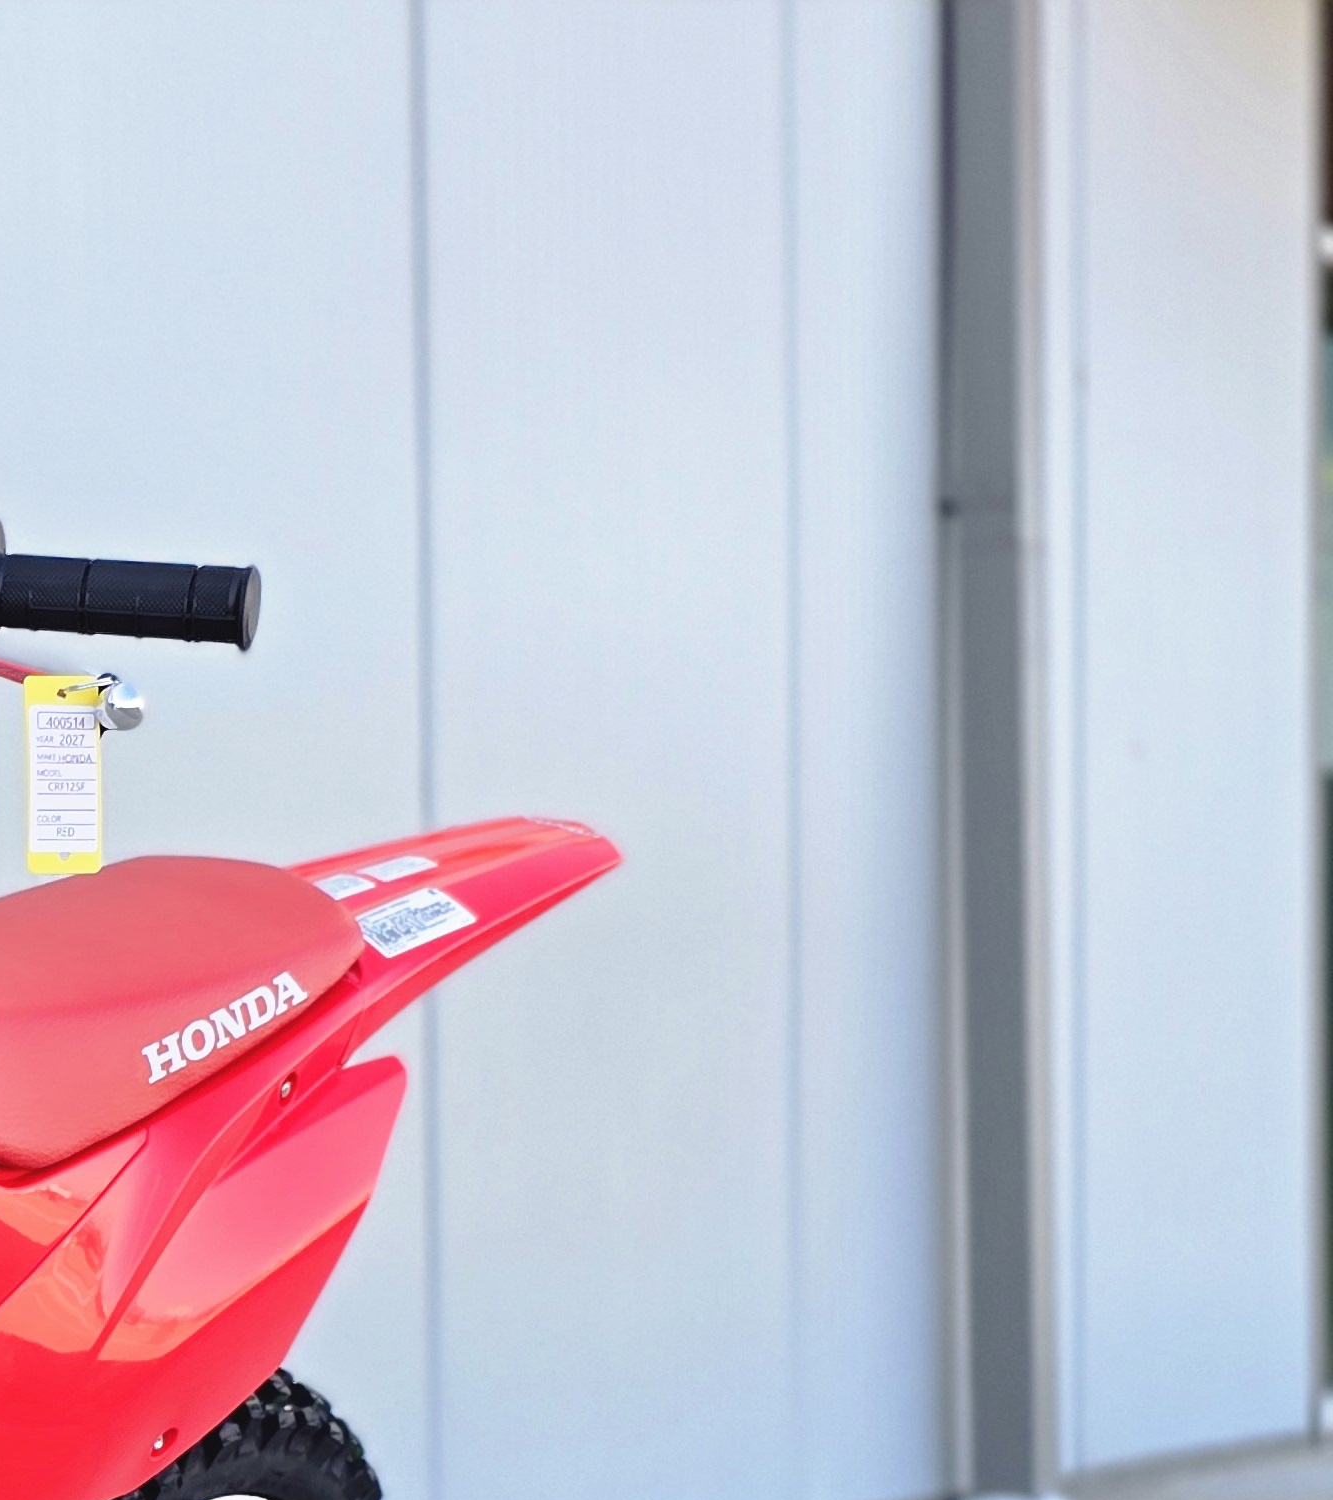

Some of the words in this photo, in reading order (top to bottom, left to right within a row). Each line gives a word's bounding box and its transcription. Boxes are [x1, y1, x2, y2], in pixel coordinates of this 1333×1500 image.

[45, 716, 85, 729] 400514
[59, 733, 85, 747] 2027
[57, 753, 94, 764] HONDA
[47, 781, 85, 791] CRF125F
[36, 814, 62, 823] COLOR
[56, 826, 75, 837] RED
[141, 971, 308, 1085] HONDA
